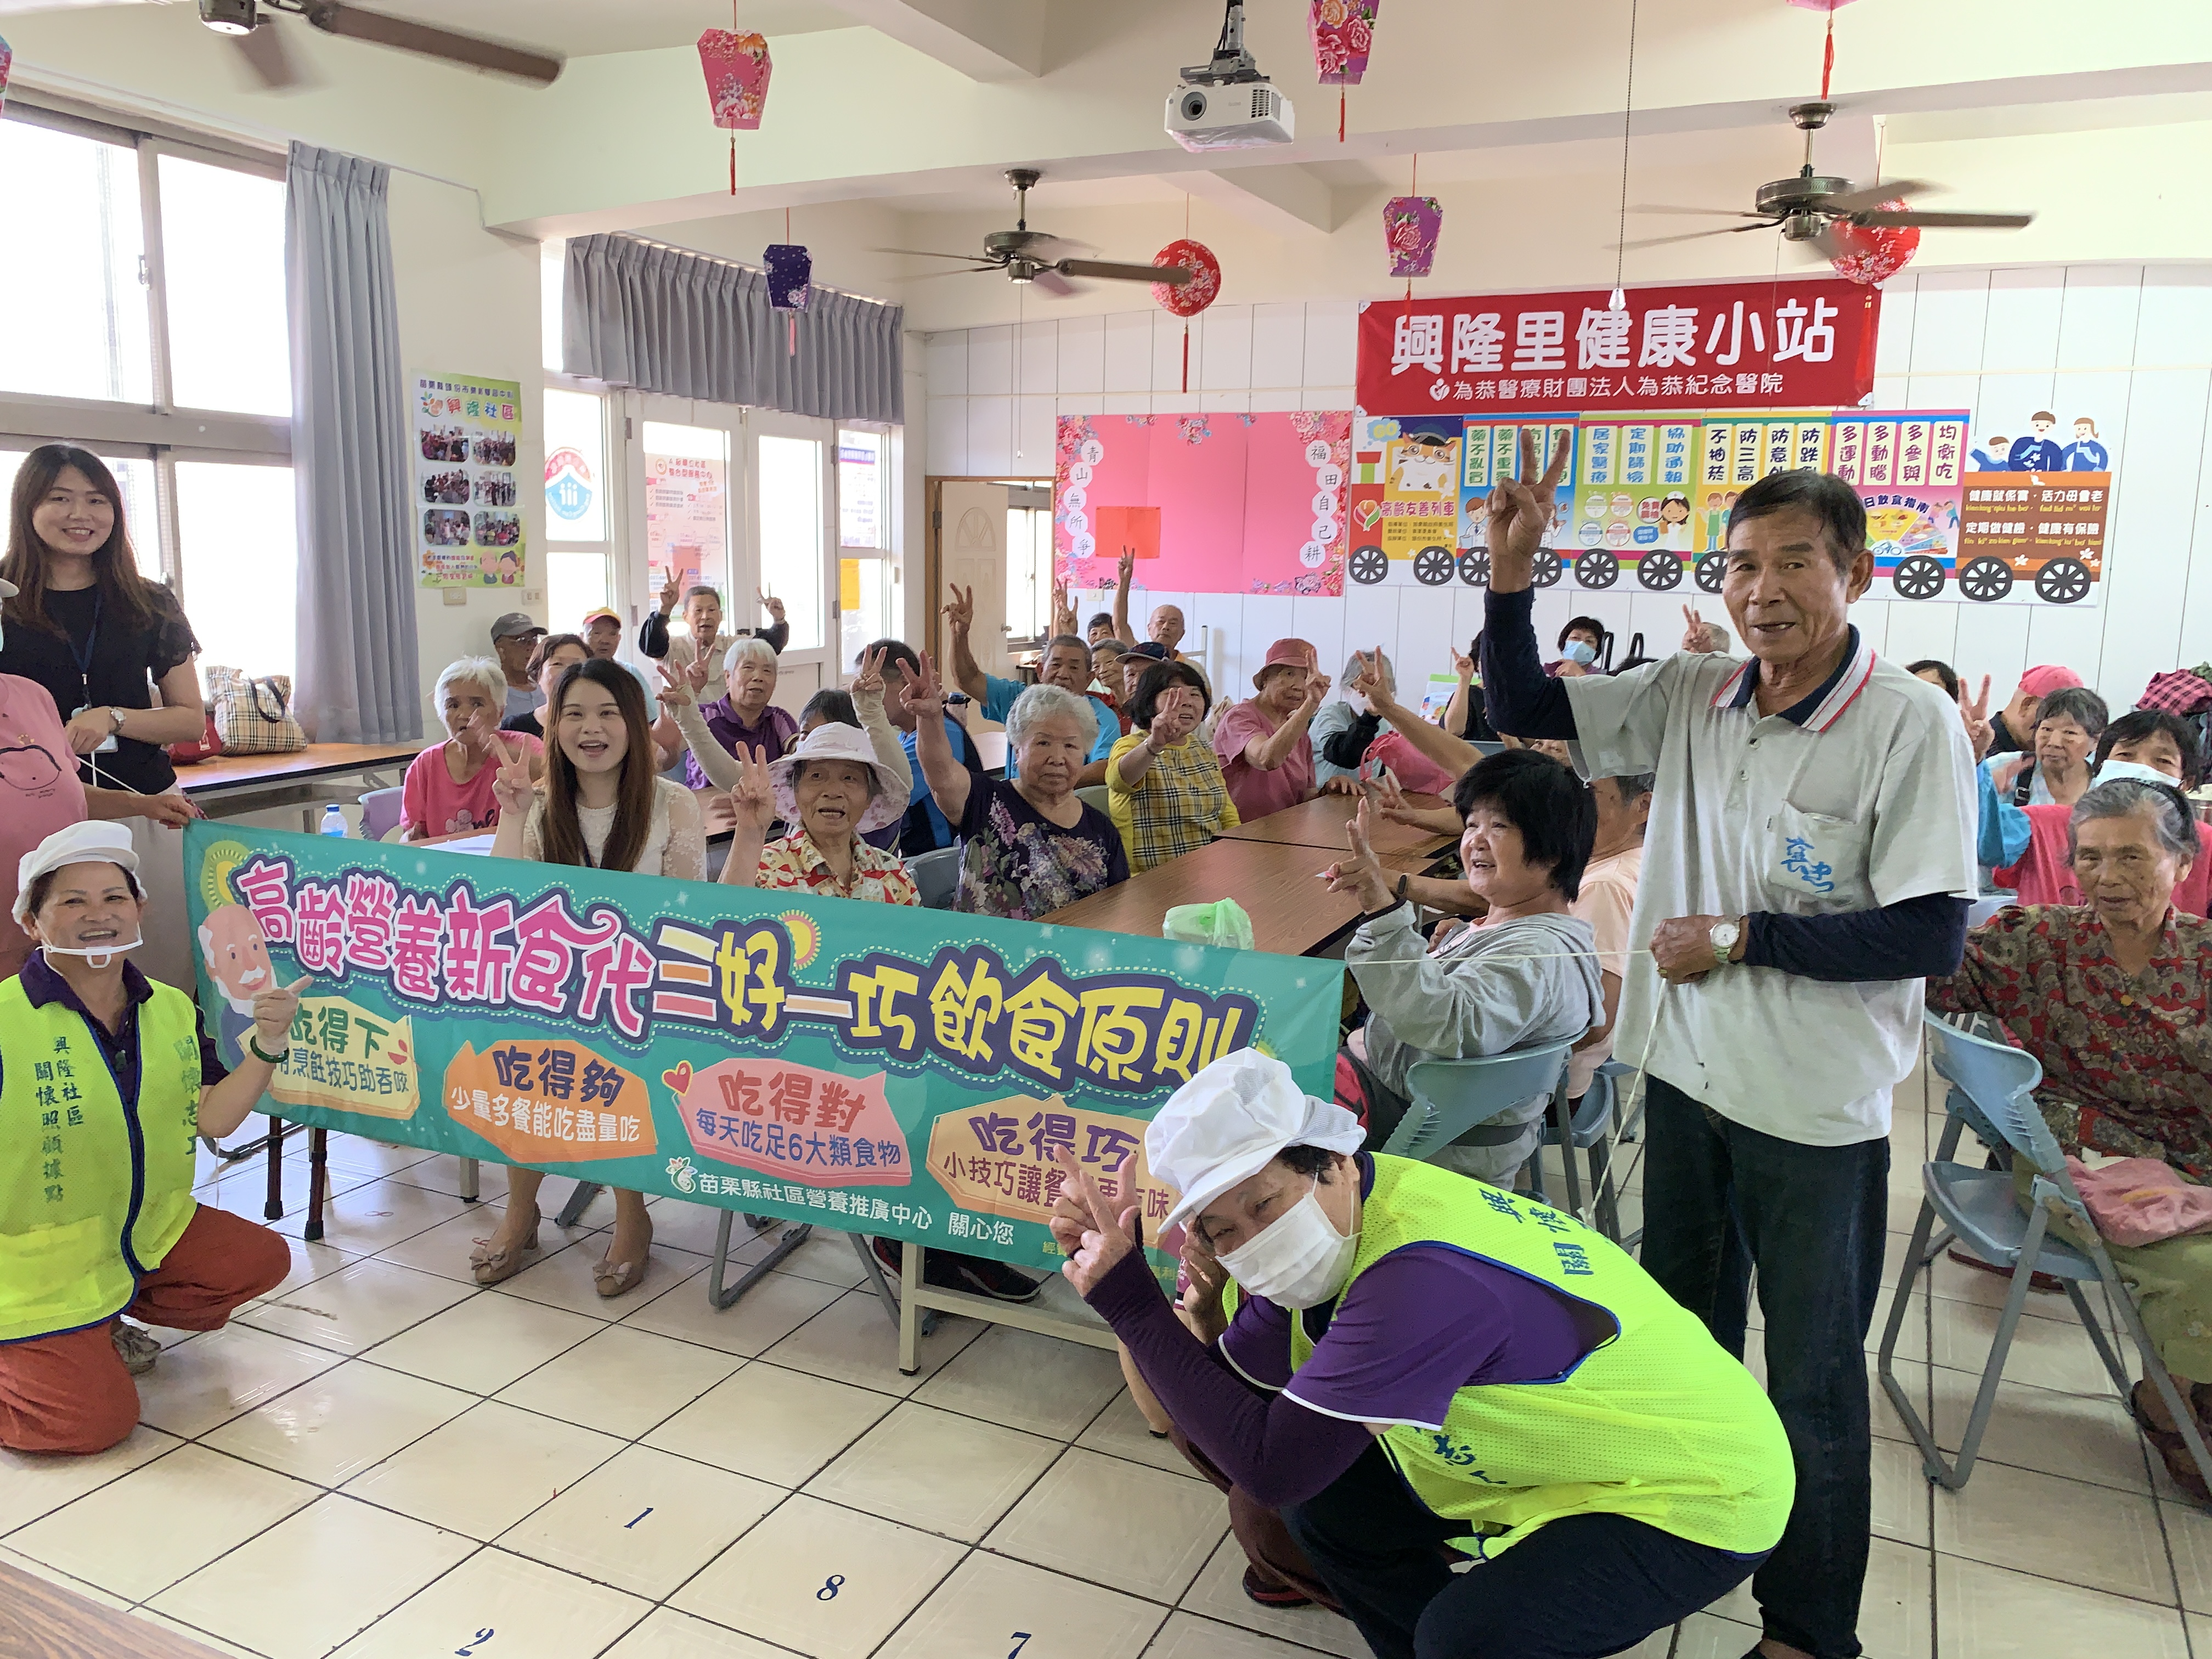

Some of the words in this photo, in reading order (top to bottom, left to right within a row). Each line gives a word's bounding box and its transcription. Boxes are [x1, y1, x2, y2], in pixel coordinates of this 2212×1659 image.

[1391, 297, 1838, 376] 興隆里健康小站
[447, 398, 514, 420] 興隆社區
[1453, 373, 1784, 400] 為恭醫療財團法人為恭紀念醫院
[1373, 421, 1398, 438] GO
[1708, 429, 1726, 481] 不抽菸
[1737, 428, 1757, 481] 防三高
[1838, 425, 1858, 481] 多運動
[1870, 425, 1889, 481] 多動腦
[1903, 425, 1922, 482] 多參與
[1936, 425, 1957, 479] 均衡吃
[1068, 445, 1099, 555] 青山無所爭
[1304, 444, 1338, 561] 福田自己耕
[1382, 501, 1454, 516] 高齡友善列車
[290, 1003, 389, 1059] 吃得下
[53, 1036, 85, 1127] 興隆社區
[494, 1045, 627, 1107] 吃得夠
[718, 1068, 866, 1133] 吃得對
[34, 1062, 64, 1203] 關懷照顧據點
[450, 1085, 641, 1144] 少量多餐能吃盡量吃
[696, 1107, 901, 1169] 每天吃足6大類食物
[968, 1111, 1141, 1172] 吃得巧
[698, 1172, 932, 1230] 苗栗縣社區營養推廣中心
[948, 1212, 1014, 1246] 關心您
[623, 1507, 654, 1530] 1
[815, 1574, 846, 1601] 8
[454, 1627, 495, 1656] 2
[1007, 1632, 1032, 1659] 7
